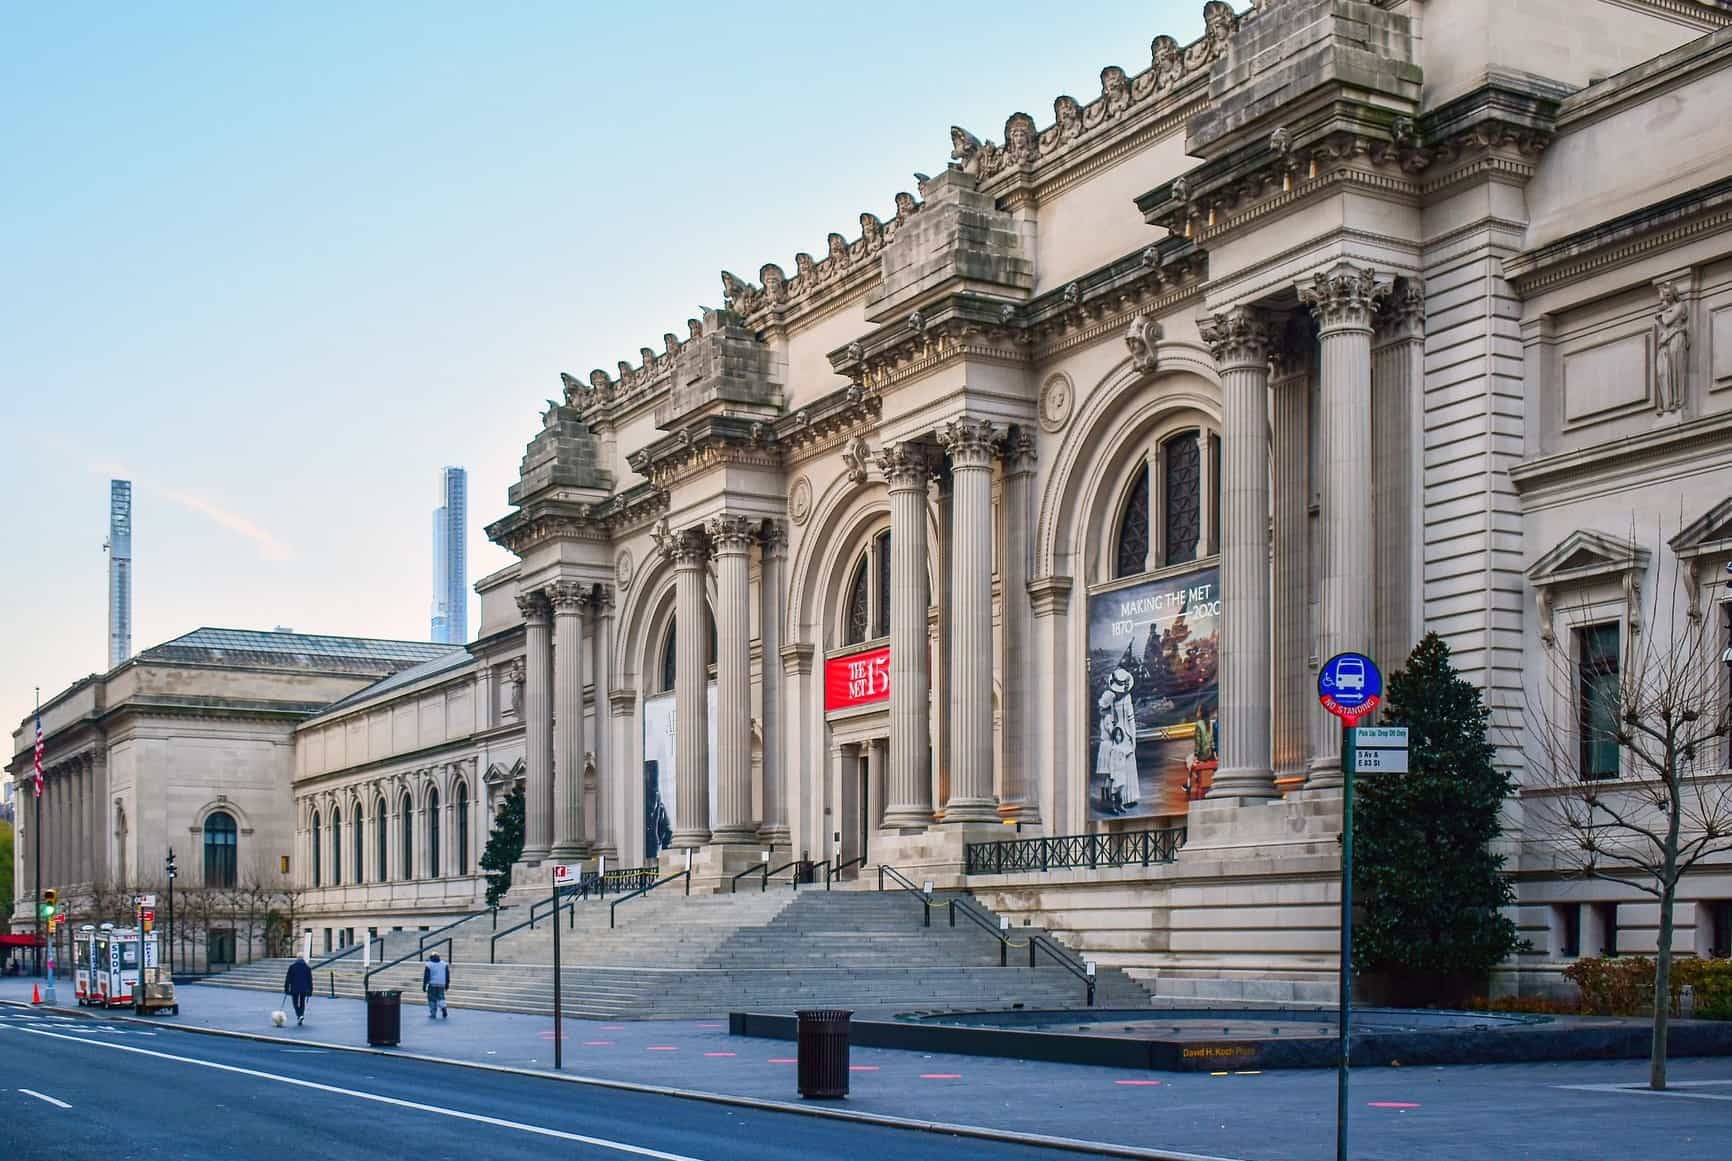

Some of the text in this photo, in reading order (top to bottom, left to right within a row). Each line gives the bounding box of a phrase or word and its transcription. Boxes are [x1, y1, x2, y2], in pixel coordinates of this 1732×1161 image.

[1121, 584, 1212, 617] MAKING THE MET
[1112, 601, 1220, 635] 1870 2020
[848, 657, 890, 695] THE 15
[848, 678, 867, 699] MET
[1326, 698, 1375, 715] NO STANDING
[1358, 759, 1363, 767] E
[1373, 759, 1380, 767] St
[111, 944, 120, 978] SODA
[1183, 1048, 1204, 1057] David
